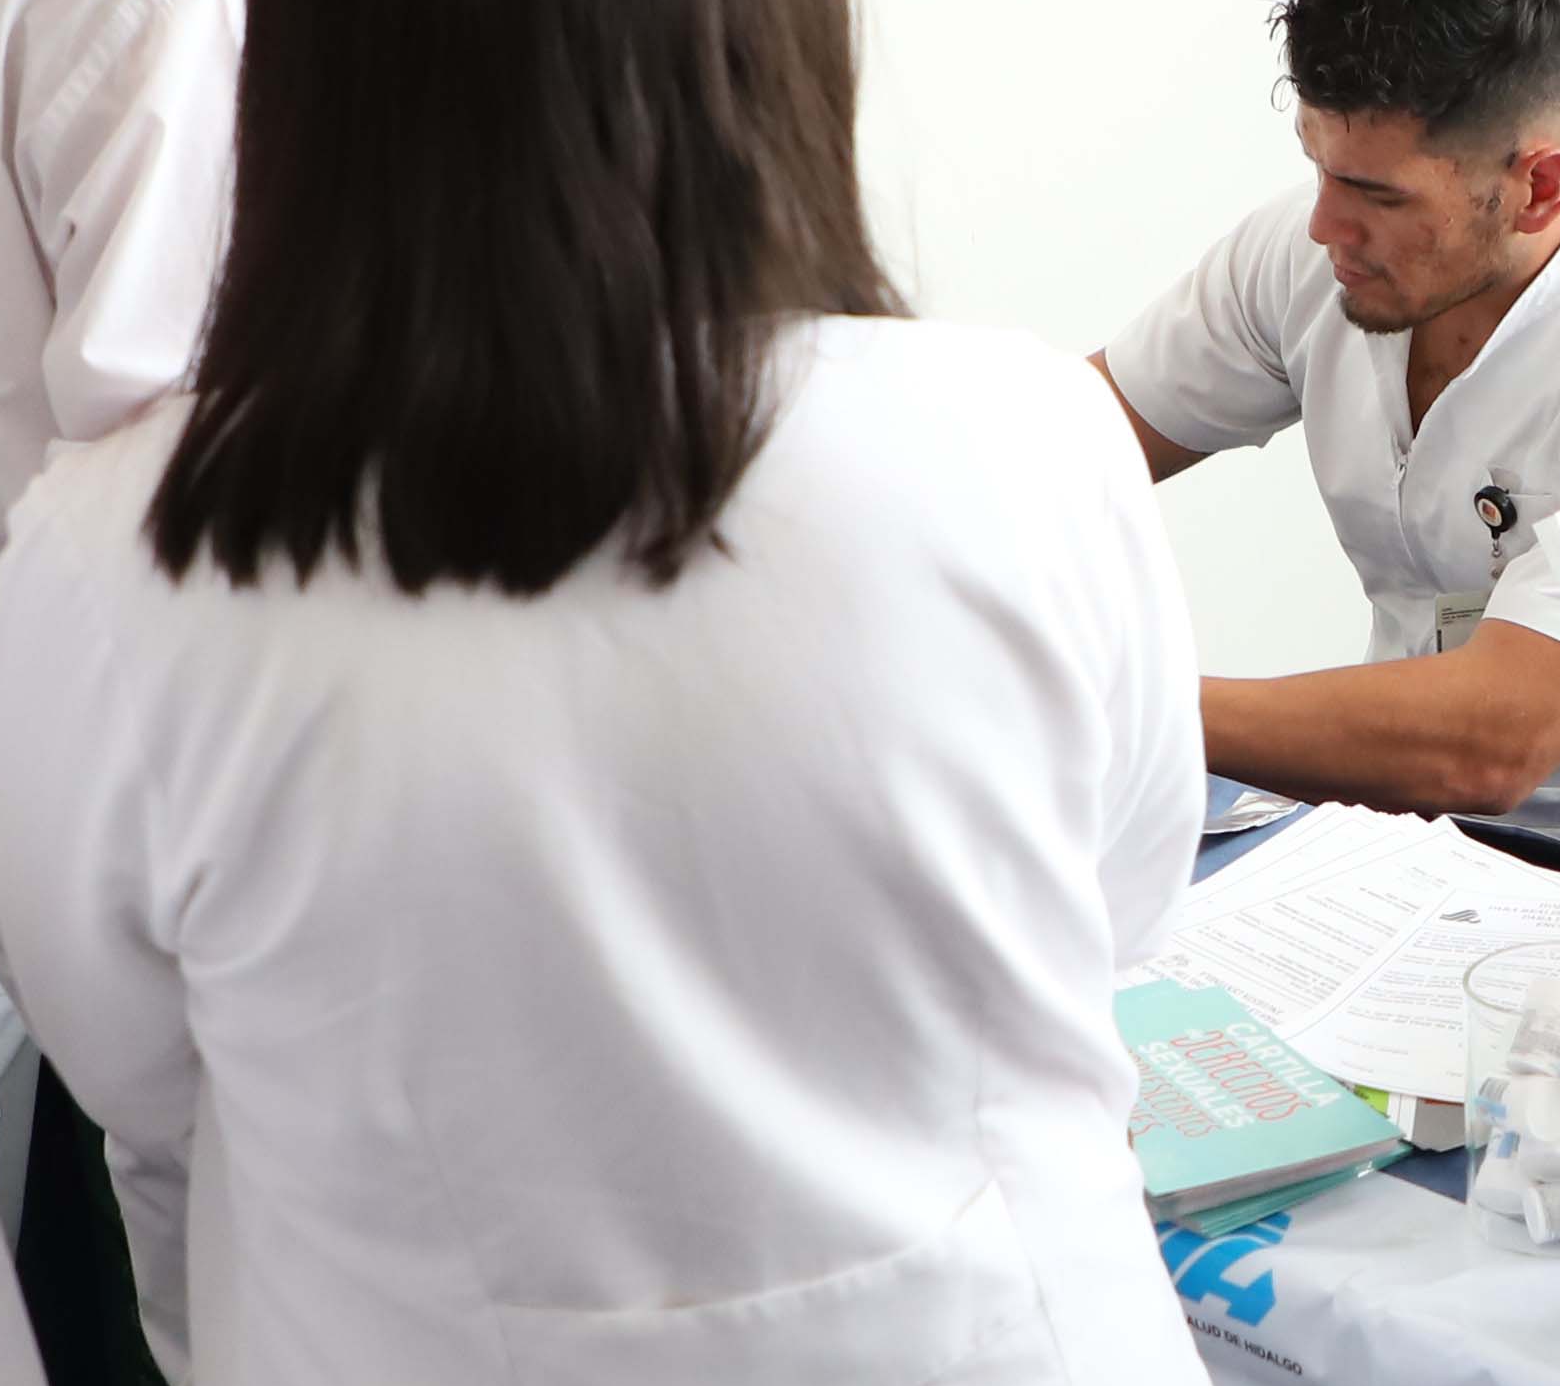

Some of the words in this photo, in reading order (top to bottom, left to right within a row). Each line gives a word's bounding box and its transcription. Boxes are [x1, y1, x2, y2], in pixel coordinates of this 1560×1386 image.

[1138, 1041, 1255, 1127] SEXUALES
[1169, 1029, 1313, 1121] DERECHOS
[1226, 1022, 1341, 1108] CARTILLA
[1187, 1314, 1222, 1338] ALUD
[1223, 1330, 1241, 1347] DE
[1244, 1338, 1303, 1376] HIDALGO
